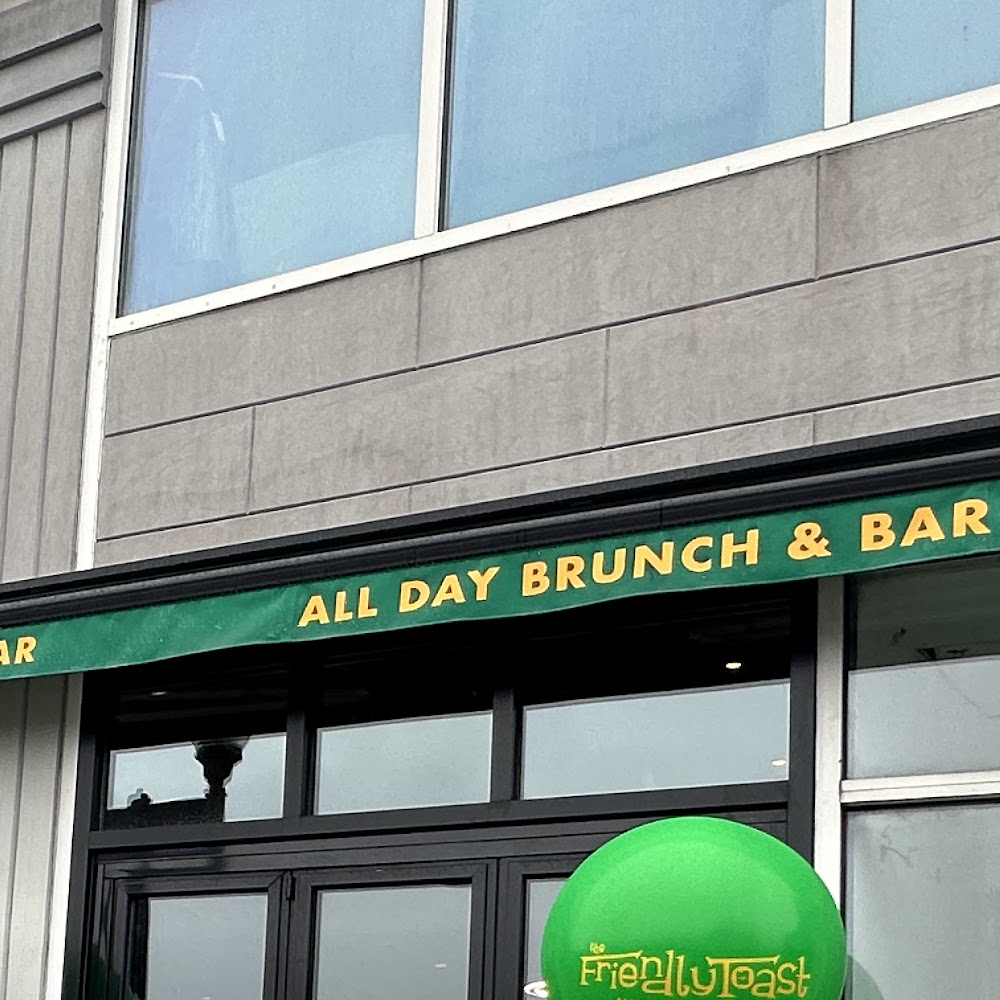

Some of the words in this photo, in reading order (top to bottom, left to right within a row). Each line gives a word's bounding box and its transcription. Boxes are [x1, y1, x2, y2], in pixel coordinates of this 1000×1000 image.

[297, 591, 379, 628] ALL
[398, 566, 501, 614] DAY
[521, 528, 761, 598] BRUNCH
[786, 521, 832, 561] &
[859, 497, 993, 553] BAR
